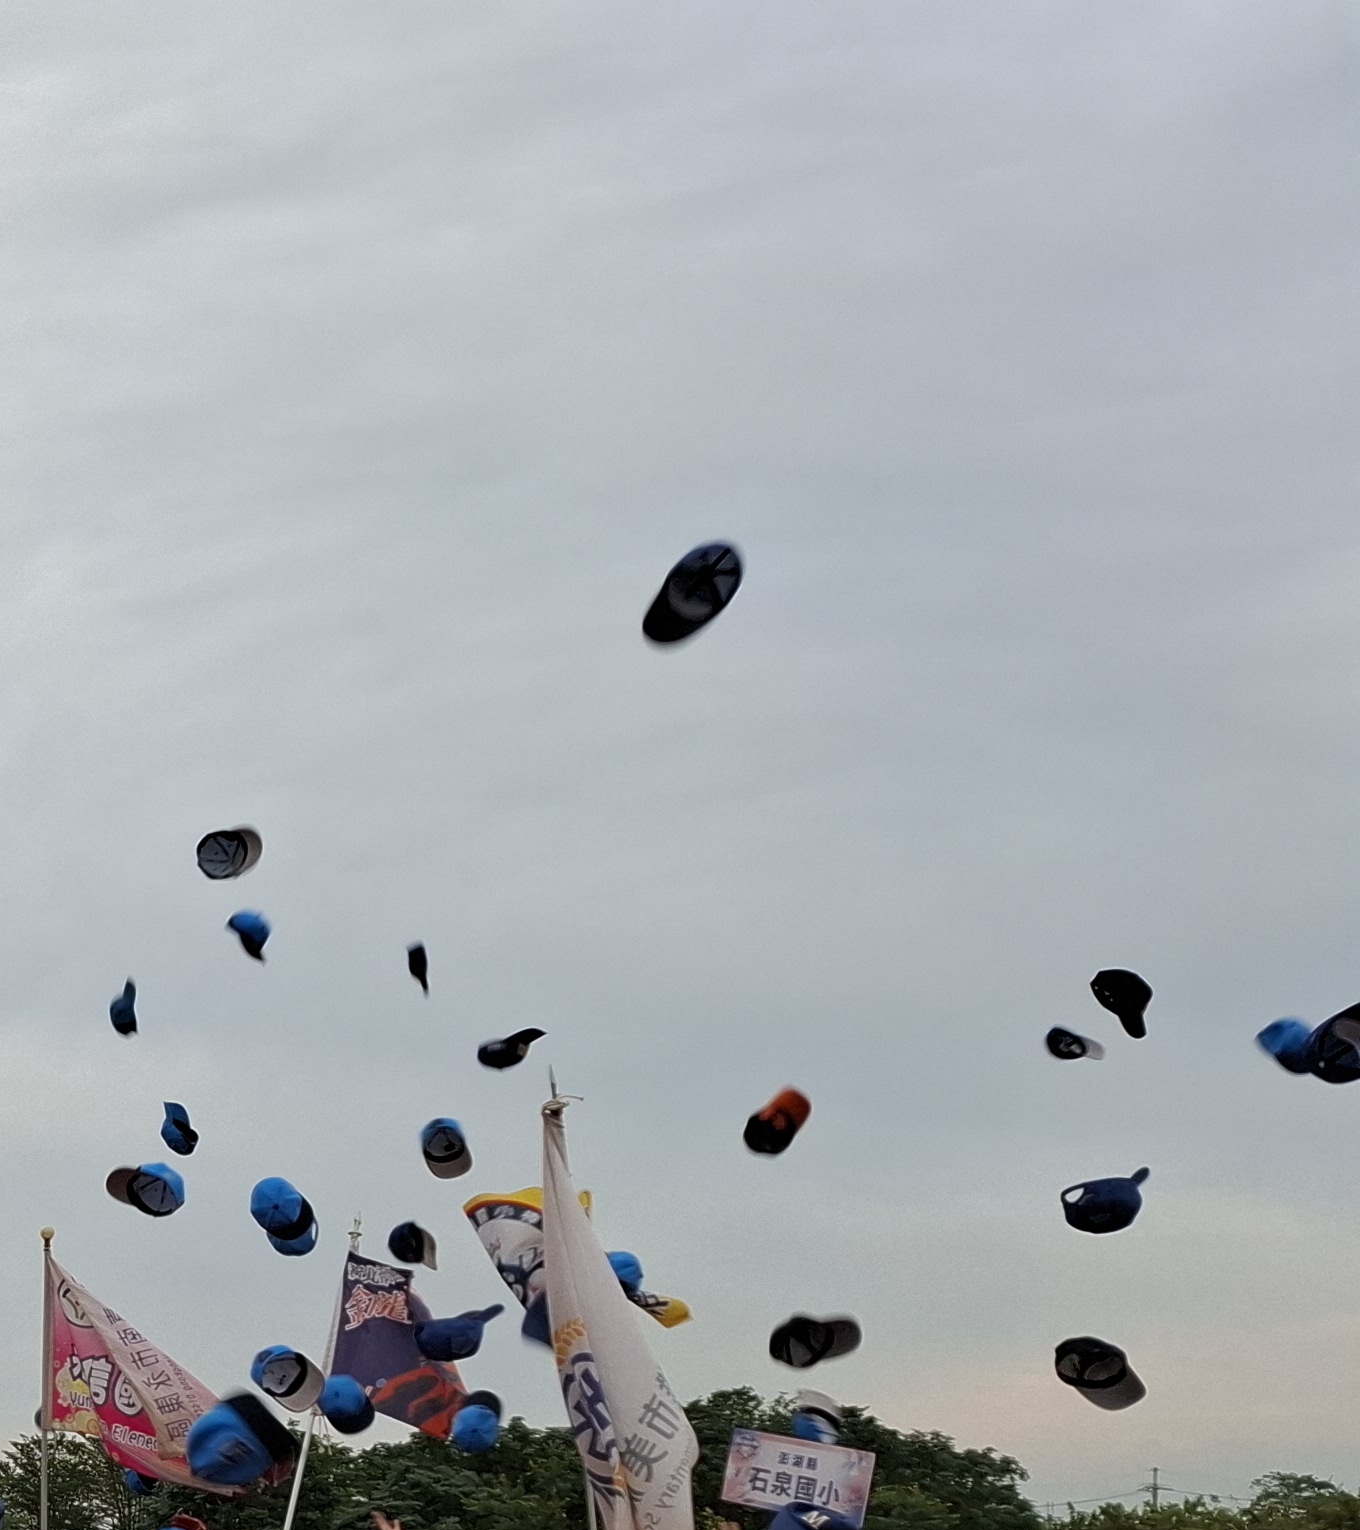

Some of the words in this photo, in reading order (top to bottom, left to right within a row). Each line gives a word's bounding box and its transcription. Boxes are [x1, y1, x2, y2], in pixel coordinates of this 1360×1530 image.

[748, 1466, 840, 1506] 石泉國小
[802, 1510, 831, 1530] M
